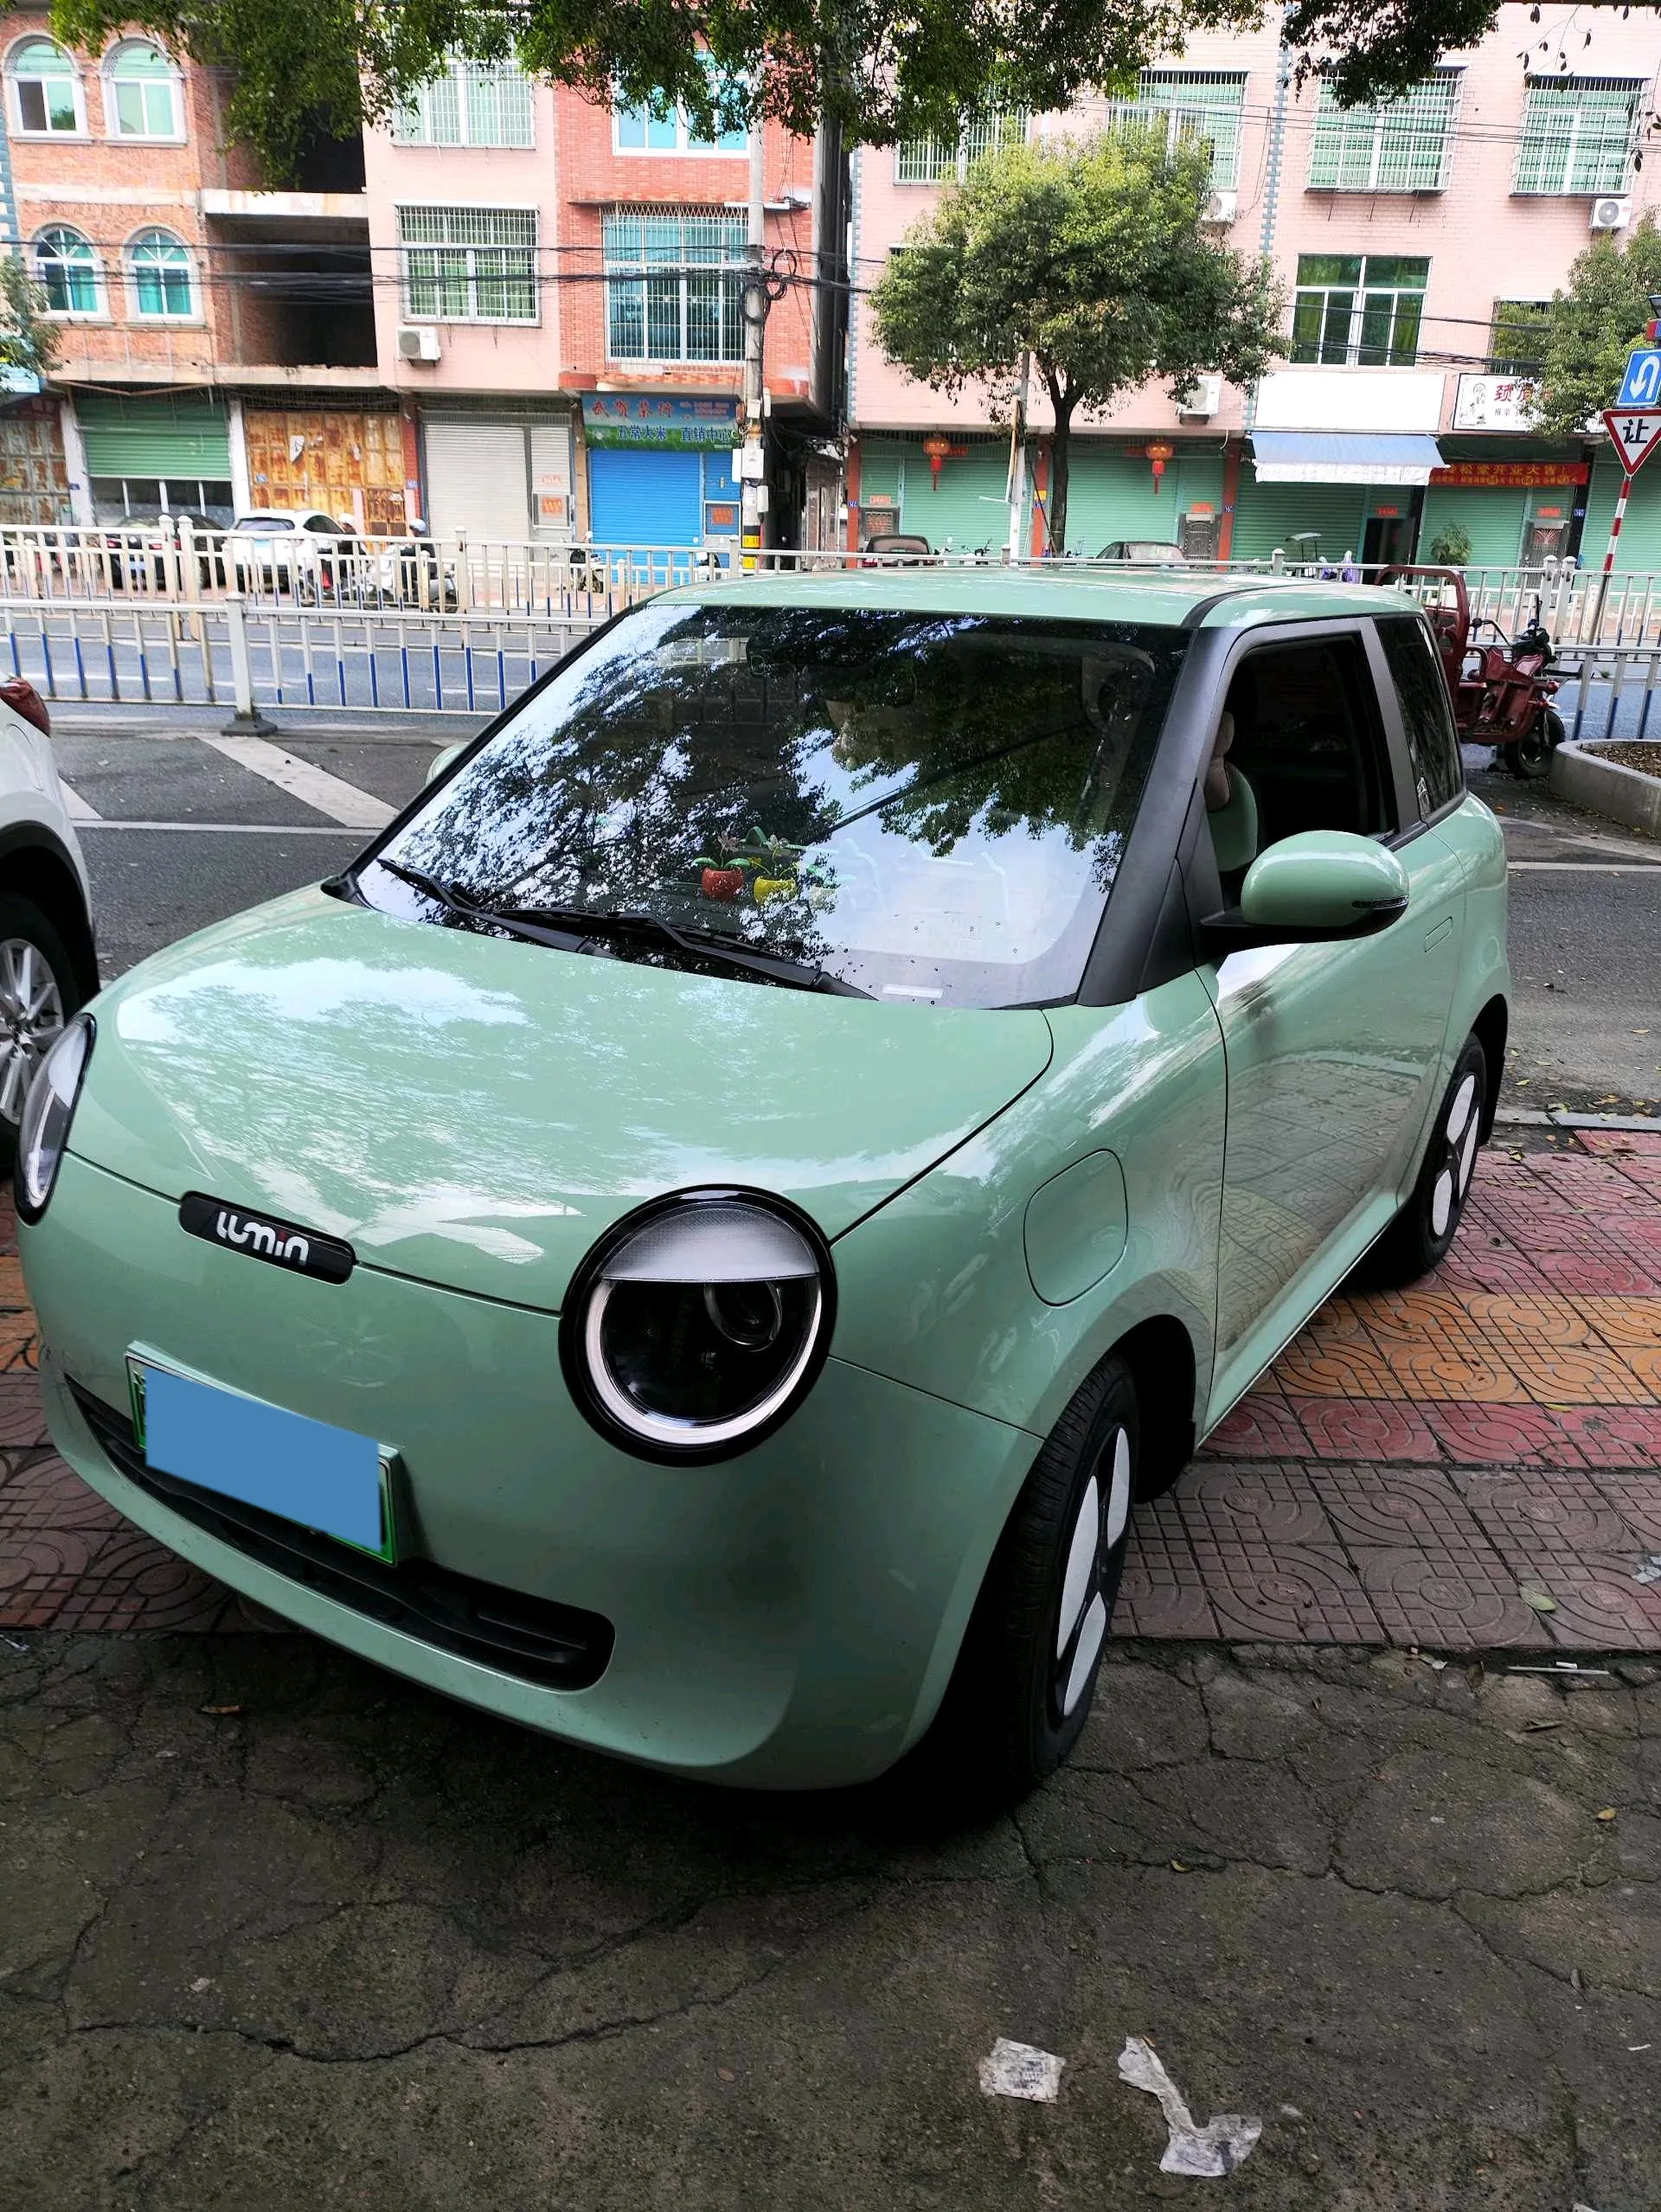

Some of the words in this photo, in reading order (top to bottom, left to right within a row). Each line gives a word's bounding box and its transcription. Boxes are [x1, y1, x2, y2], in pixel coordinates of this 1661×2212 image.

[618, 425, 667, 442] 五常大米
[680, 426, 732, 443] 直销中心
[1623, 418, 1650, 444] 让
